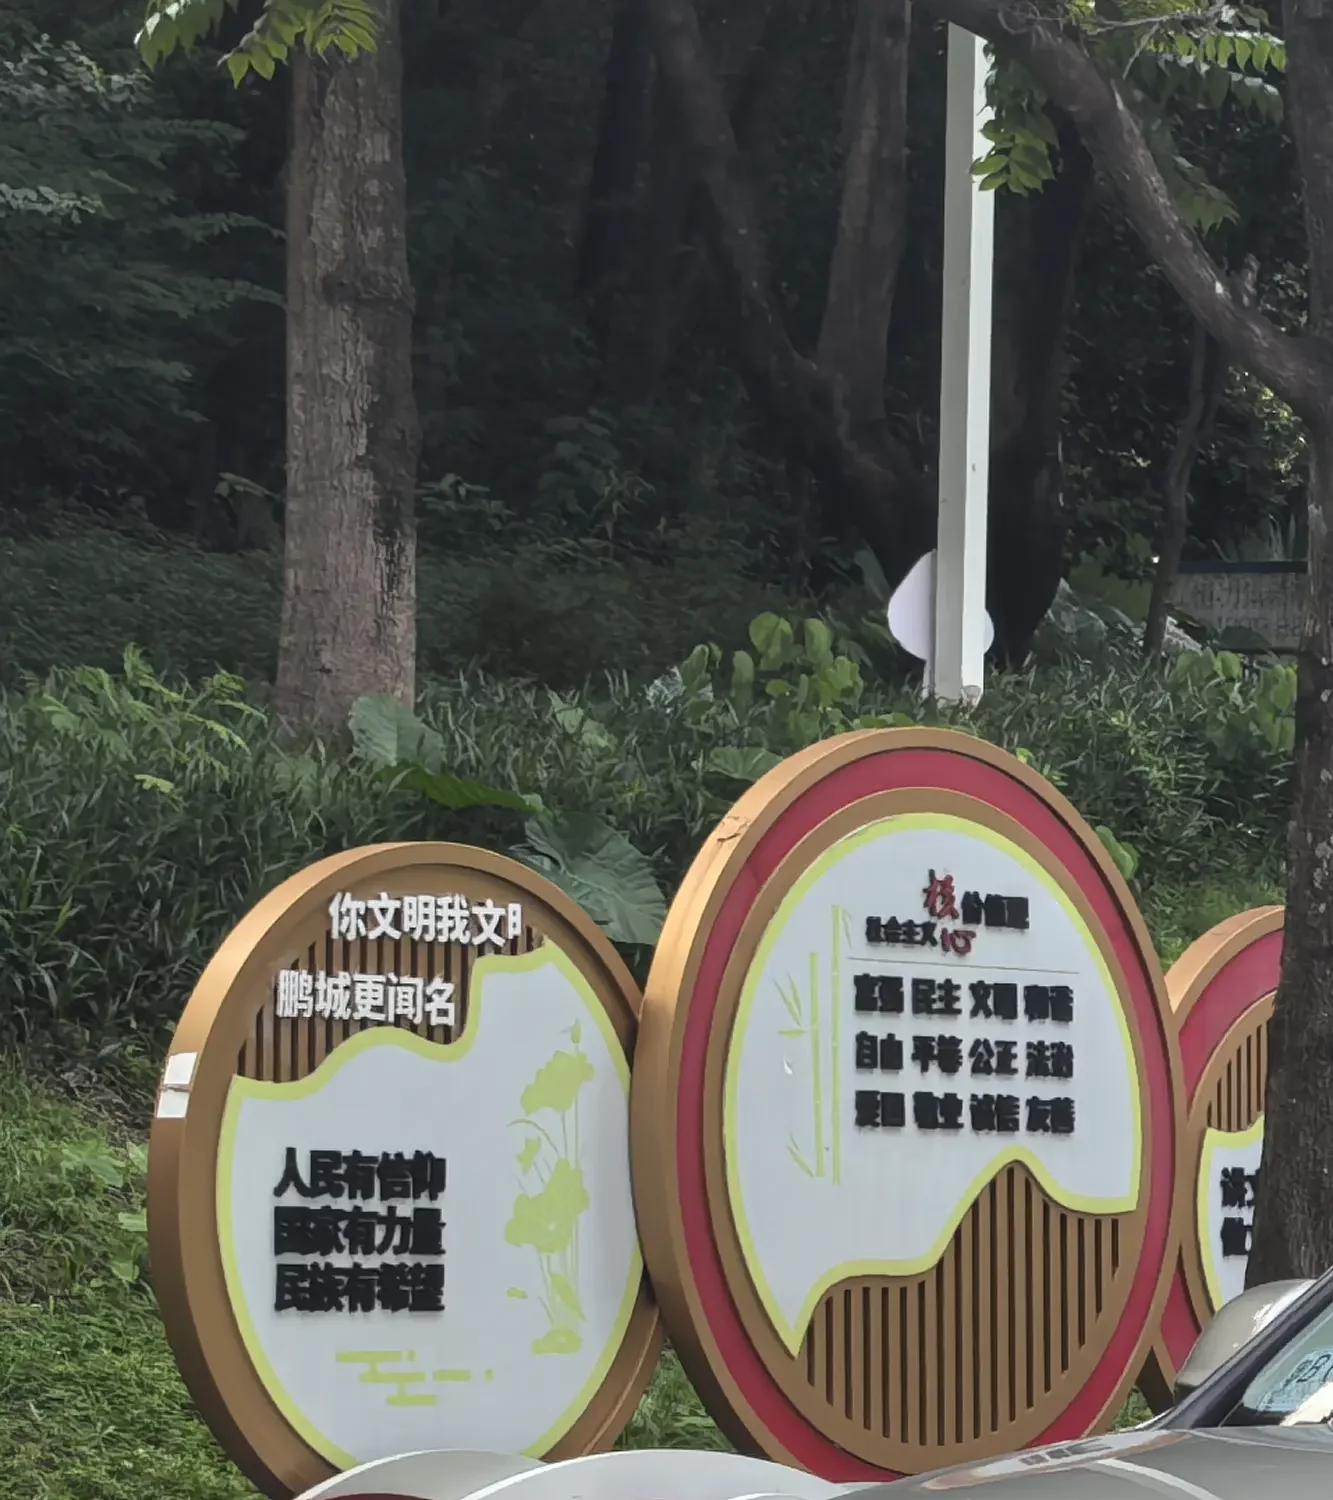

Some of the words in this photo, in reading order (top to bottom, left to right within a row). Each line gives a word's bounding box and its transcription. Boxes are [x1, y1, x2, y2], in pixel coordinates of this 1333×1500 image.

[276, 969, 456, 1027] 鹏城更闻名
[273, 1147, 447, 1203] 人民有信仰
[273, 1204, 447, 1257] 国家有力量
[273, 1261, 446, 1313] 民族有希望
